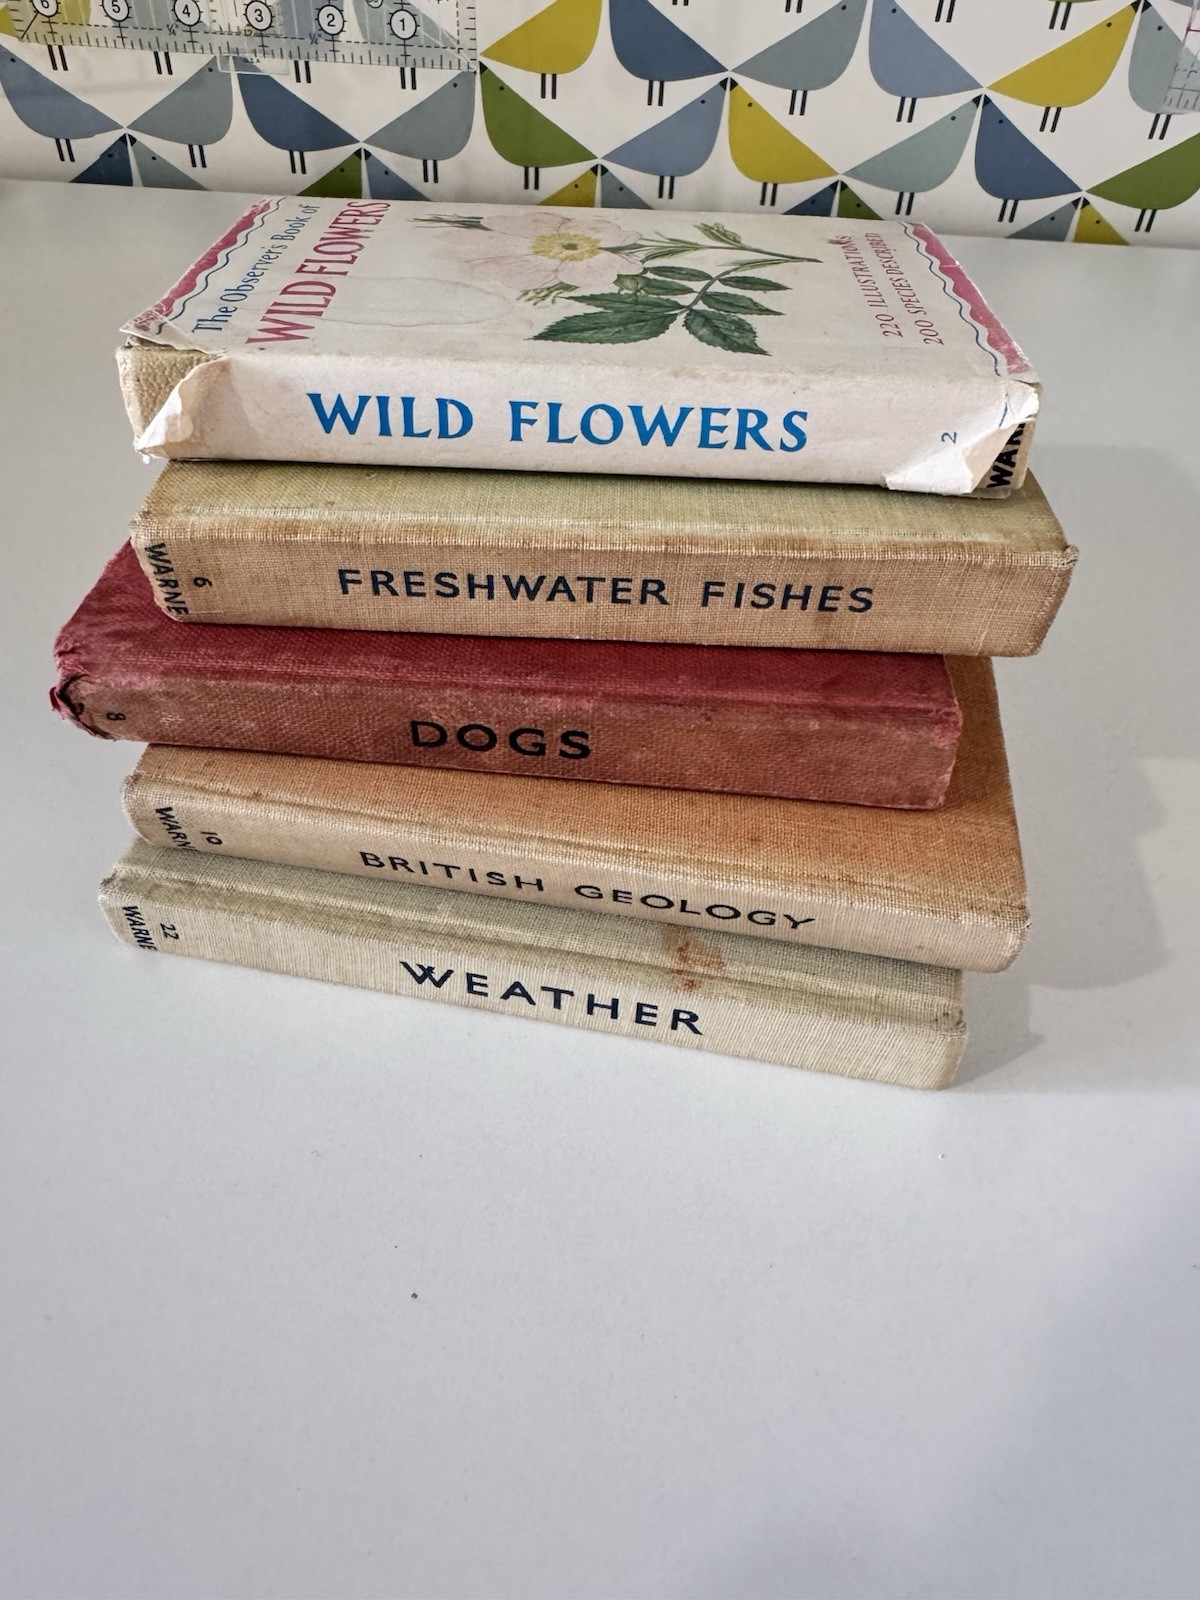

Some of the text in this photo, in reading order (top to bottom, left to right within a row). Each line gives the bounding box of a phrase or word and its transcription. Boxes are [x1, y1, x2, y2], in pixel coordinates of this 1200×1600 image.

[111, 0, 121, 13] 5
[182, 4, 191, 18] 4
[254, 8, 263, 22] 3
[326, 13, 336, 27] 2
[399, 18, 406, 31] 1
[191, 203, 320, 333] The Observer's Book of
[245, 201, 391, 344] WILD FLOWERS
[835, 235, 904, 338] 220 ILLUSTRATIONS
[865, 232, 945, 345] 200 SPECIES DESCRIBED
[307, 392, 808, 452] WILD FLOWERS
[941, 431, 957, 444] 2
[144, 542, 189, 615] WARNE
[193, 576, 213, 588] 6
[337, 568, 875, 614] FRESHWATER FISHES
[106, 712, 127, 721] 8
[410, 720, 591, 760] DOGS
[154, 806, 201, 852] WARN
[201, 830, 223, 846] 10
[359, 851, 815, 930] BRITISH GEOLOGY
[122, 905, 158, 951] WARNE
[160, 922, 180, 940] 22
[400, 960, 703, 1035] WEATHER
